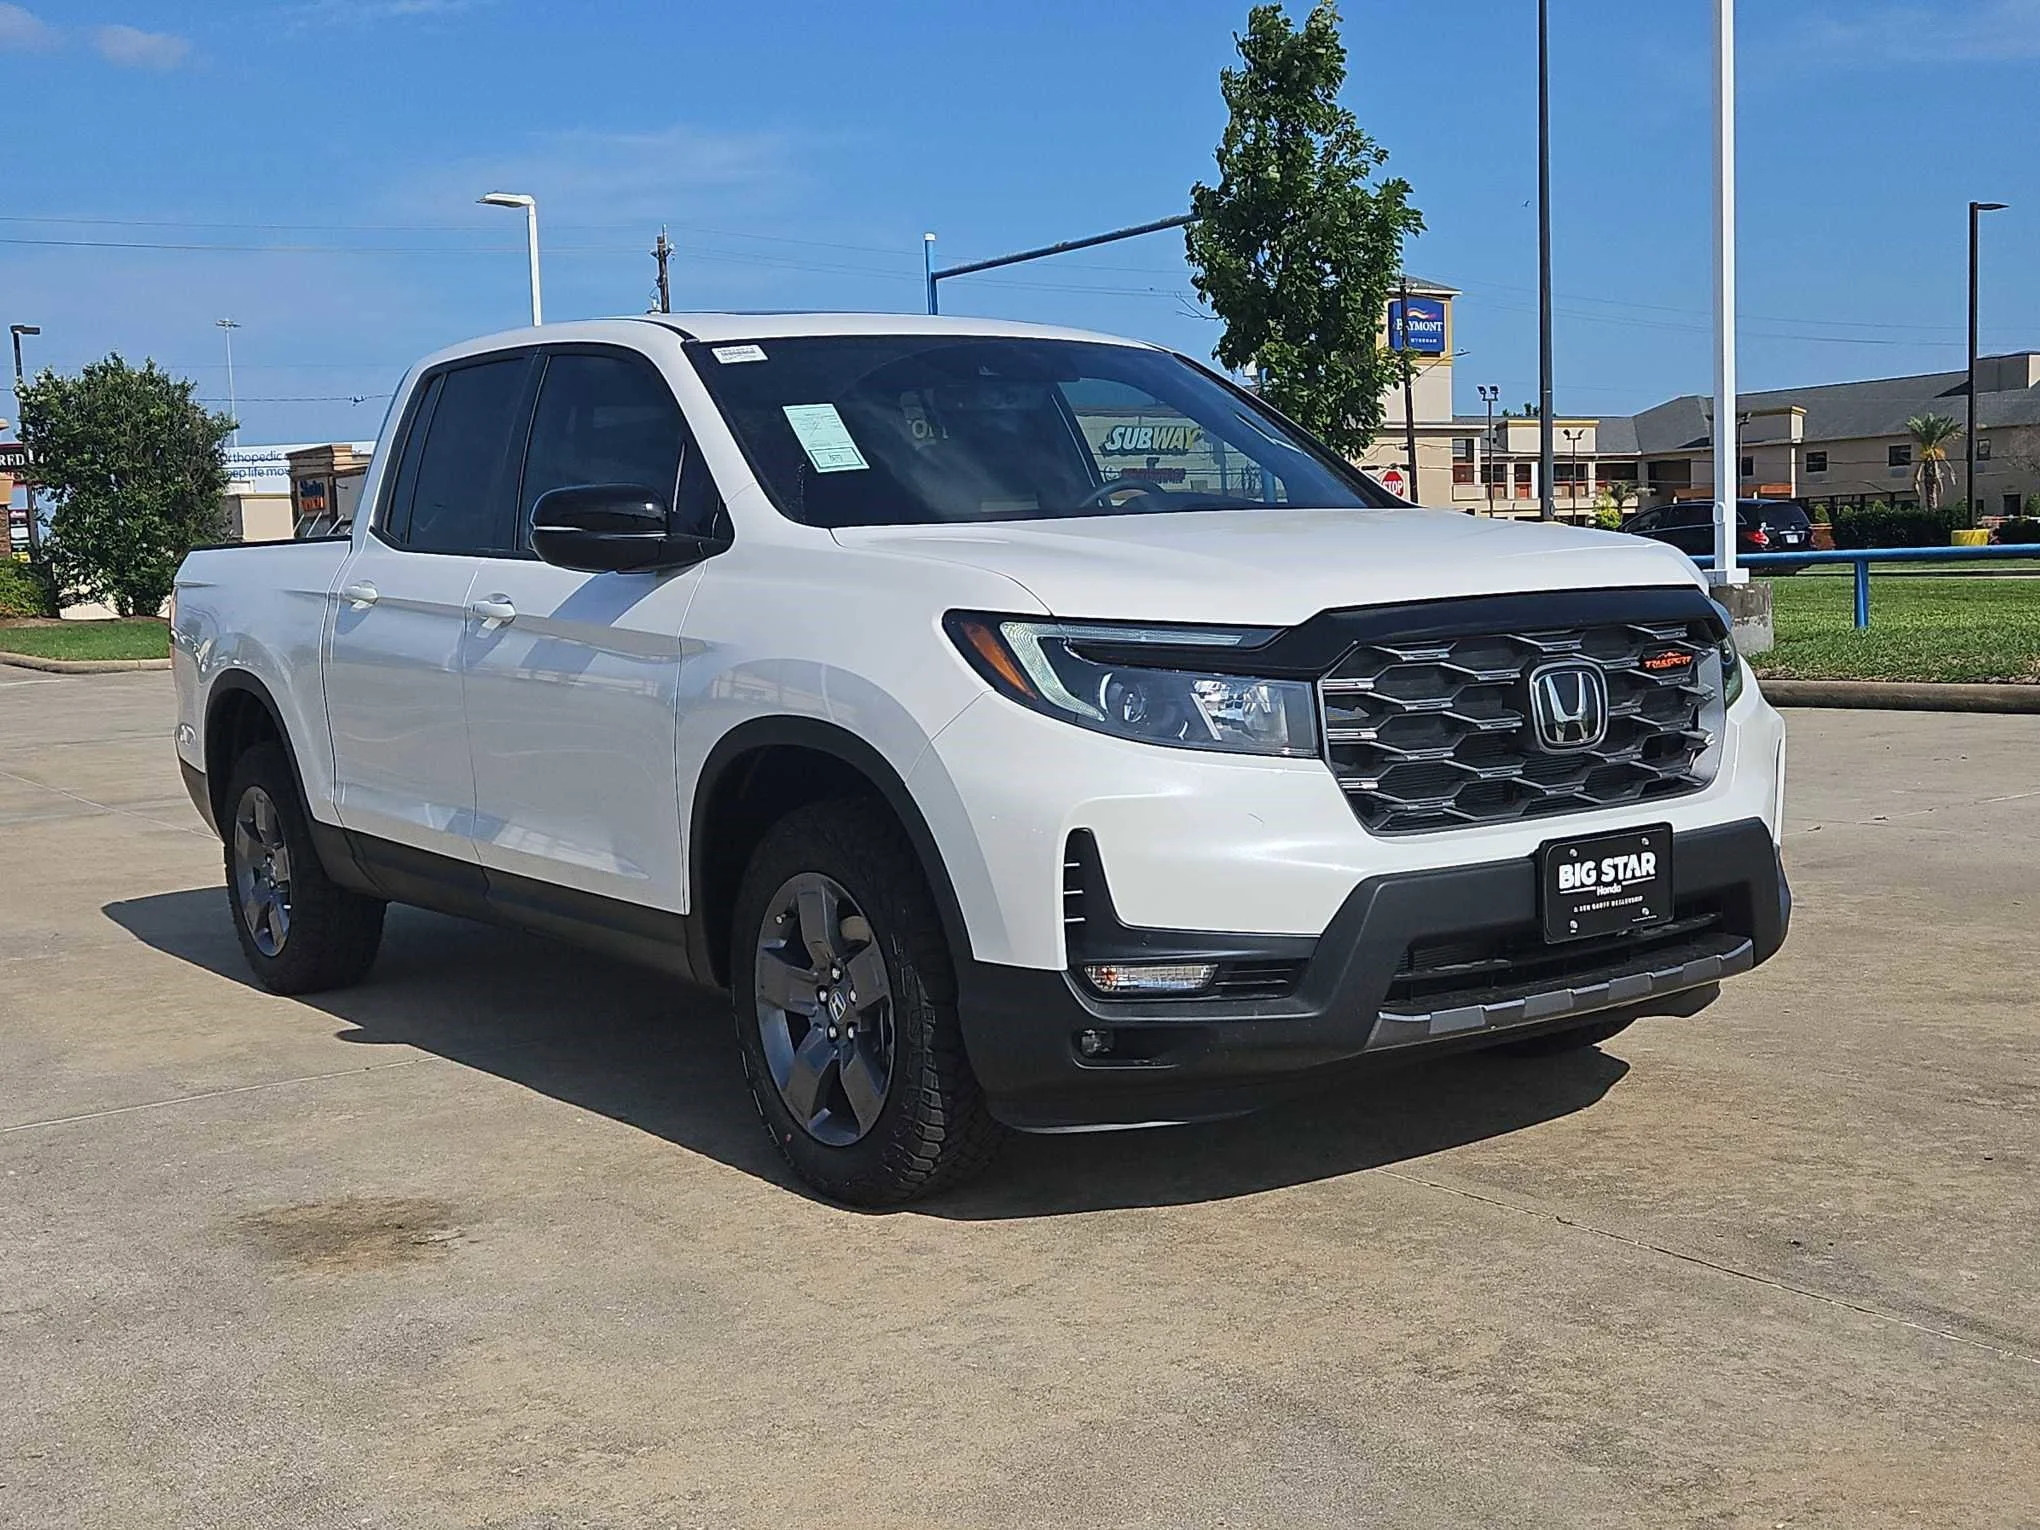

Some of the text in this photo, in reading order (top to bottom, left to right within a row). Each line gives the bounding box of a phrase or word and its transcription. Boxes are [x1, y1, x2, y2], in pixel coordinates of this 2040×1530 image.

[1396, 318, 1443, 331] BYMONT
[1104, 427, 1201, 450] SUBWAY
[1383, 480, 1403, 494] STOP
[1559, 852, 1656, 889] BIG STAR
[1596, 883, 1622, 896] Honda
